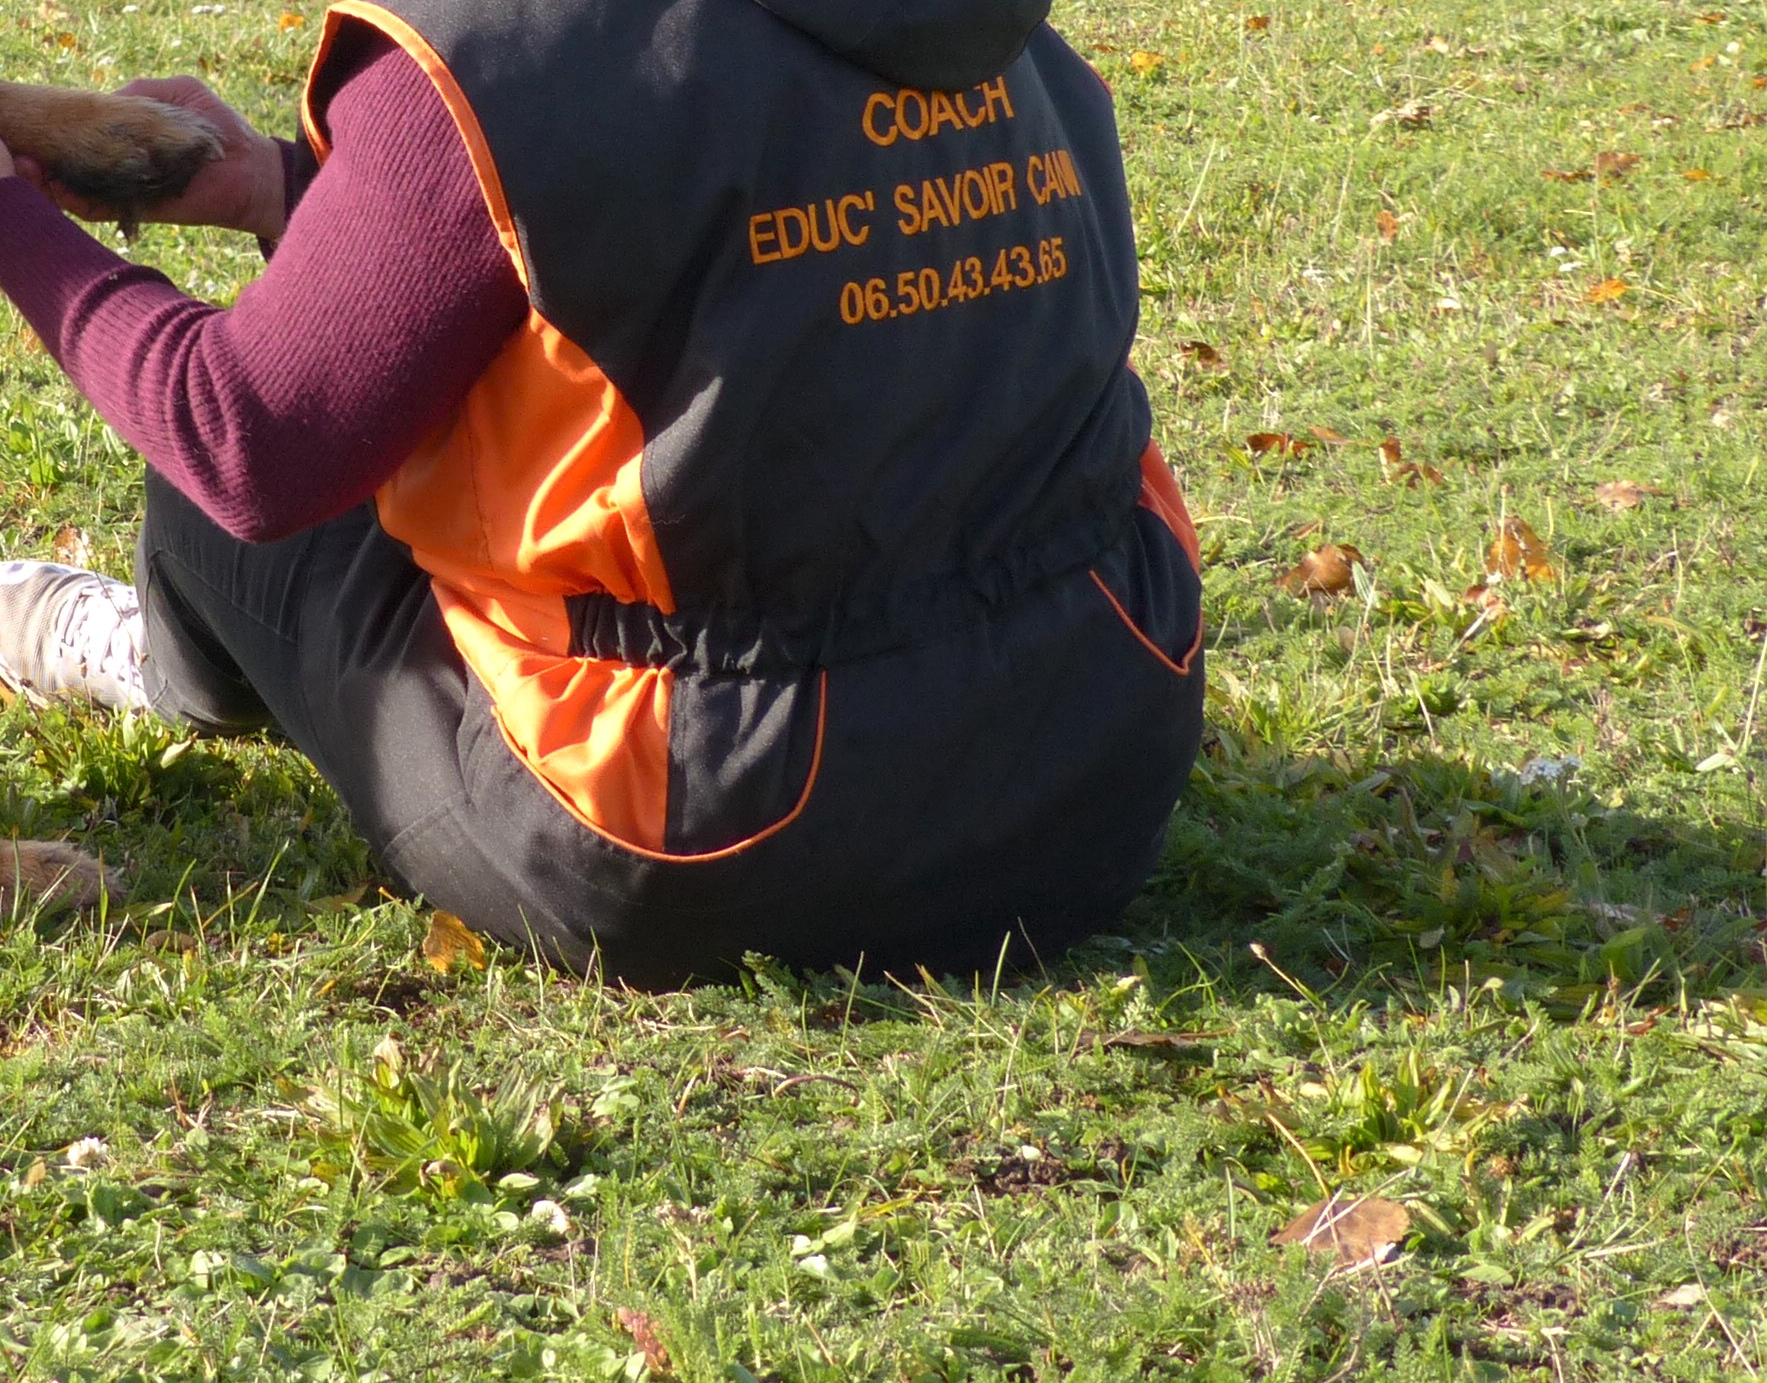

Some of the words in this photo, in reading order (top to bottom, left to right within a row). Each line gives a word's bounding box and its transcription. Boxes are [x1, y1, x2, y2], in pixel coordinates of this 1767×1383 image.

[862, 76, 1015, 146] COACH
[749, 190, 874, 265] EDUC'
[894, 162, 1017, 235] SAVOIR
[840, 237, 1068, 324] 06.50.43.43.65
